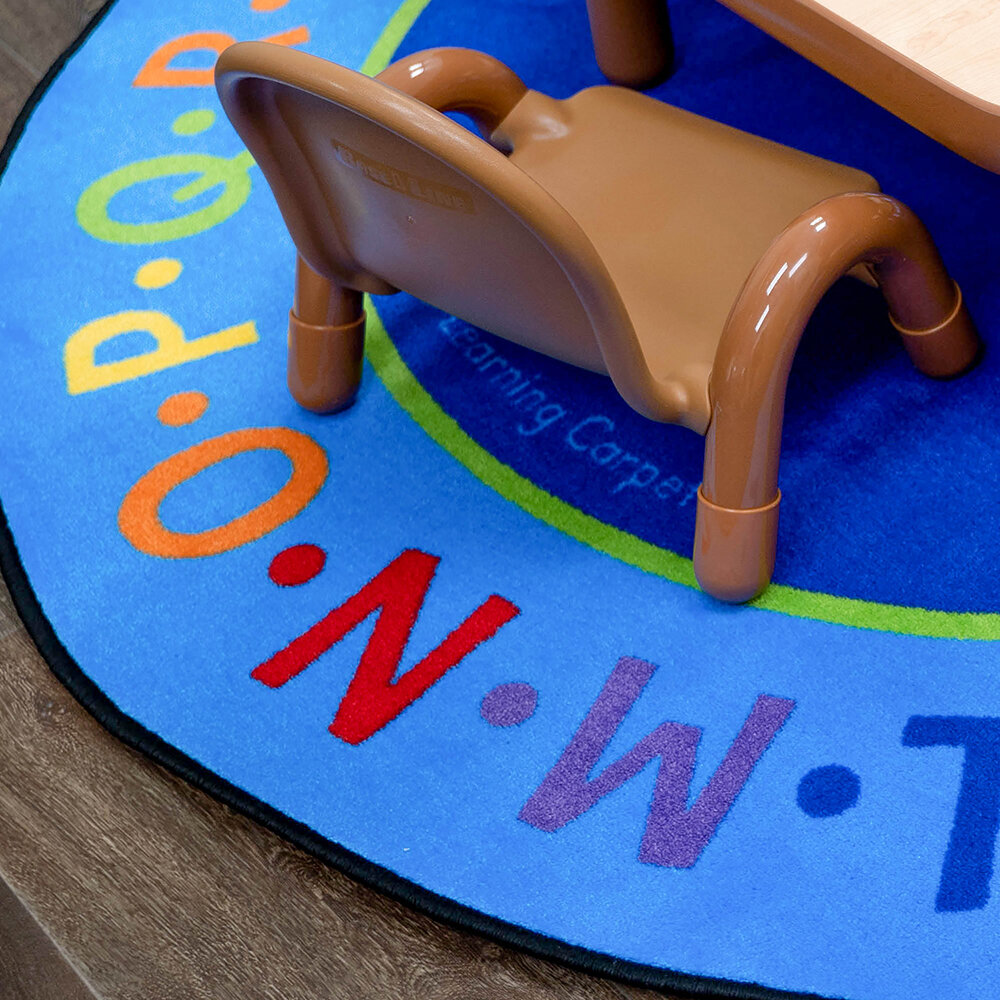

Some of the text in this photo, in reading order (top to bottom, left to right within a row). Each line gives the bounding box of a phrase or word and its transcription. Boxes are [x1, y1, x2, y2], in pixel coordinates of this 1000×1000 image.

[76, 151, 256, 244] Q
[64, 311, 259, 395] P
[117, 427, 330, 559] O
[250, 548, 520, 746] N
[518, 656, 797, 868] M
